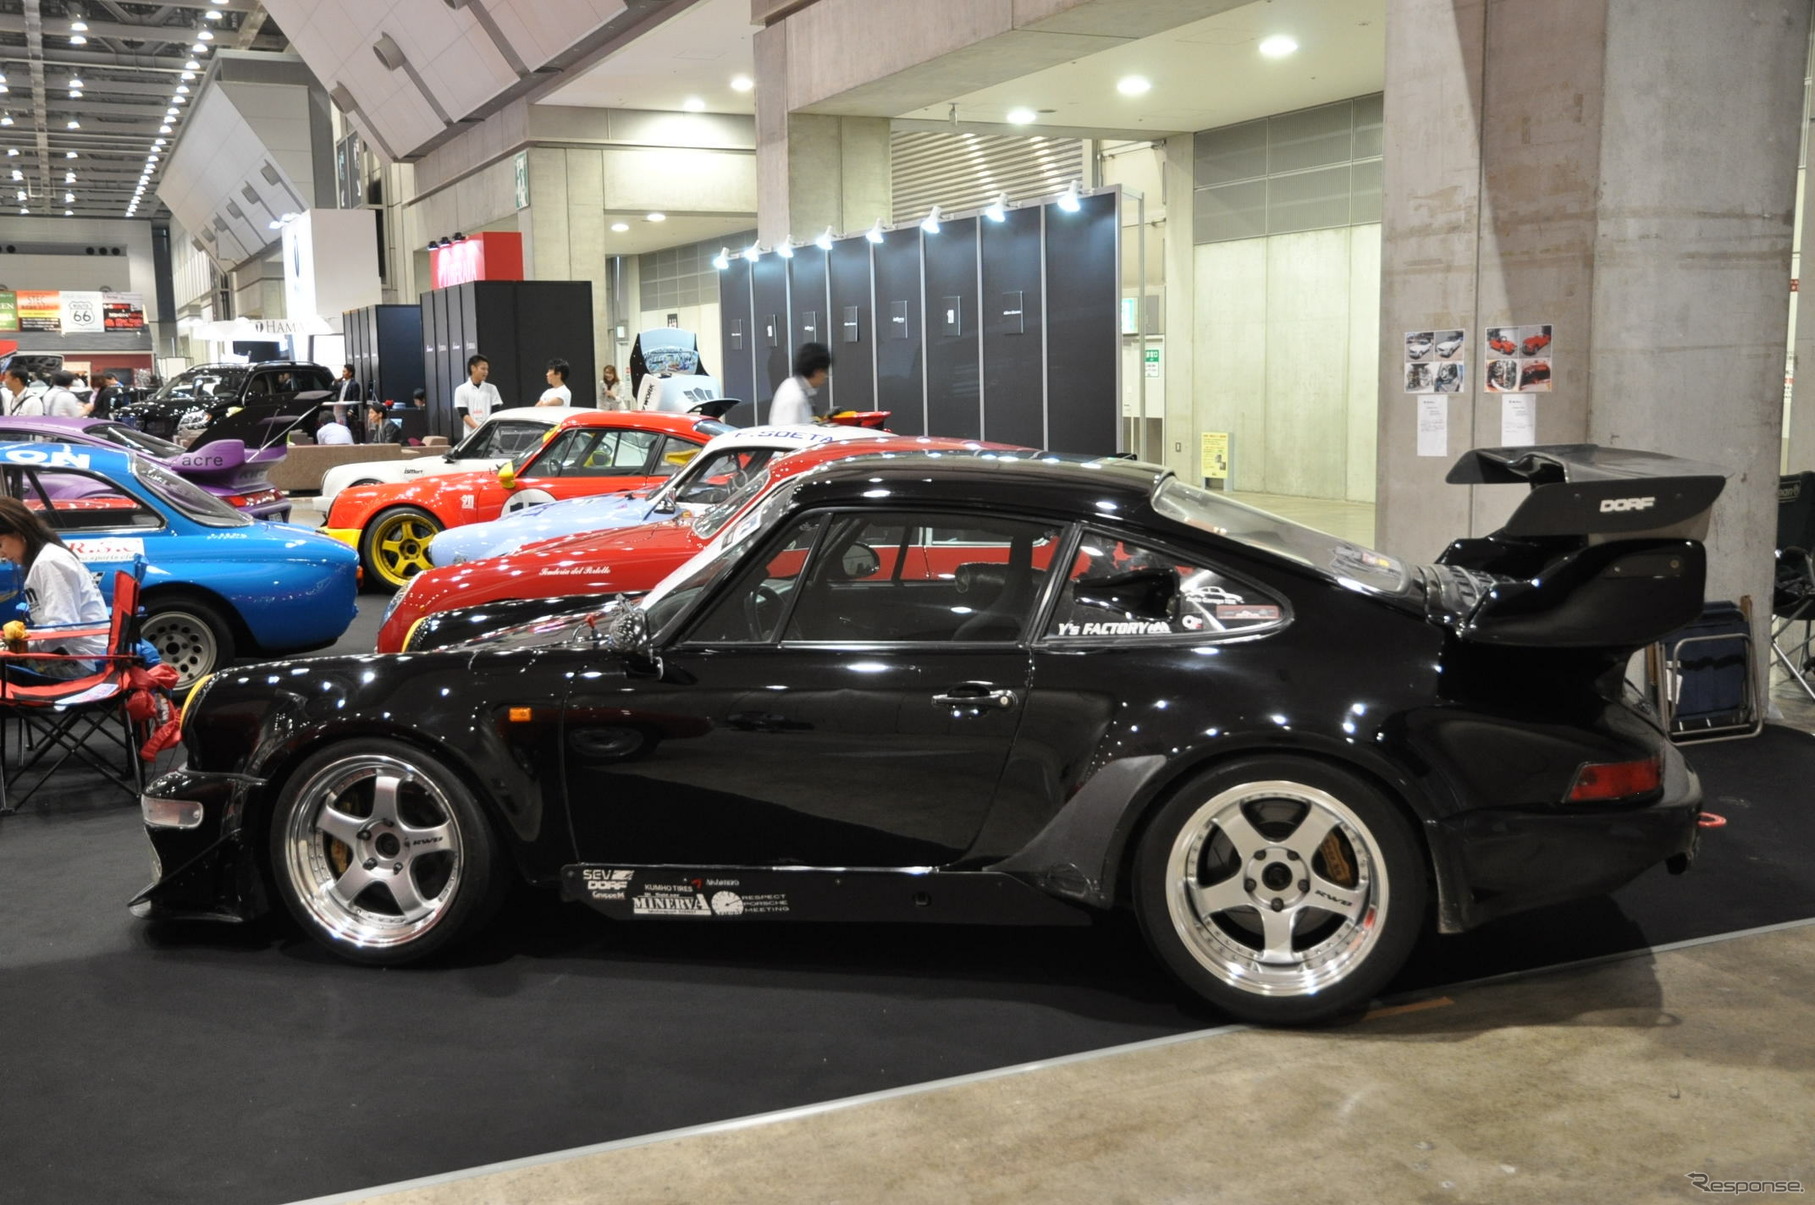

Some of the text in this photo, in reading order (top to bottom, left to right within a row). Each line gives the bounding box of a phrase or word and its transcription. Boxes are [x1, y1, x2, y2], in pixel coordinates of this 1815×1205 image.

[73, 310, 92, 322] 66
[182, 455, 224, 467] acre
[1599, 497, 1656, 513] DORF
[571, 566, 585, 580] del
[1058, 621, 1149, 636] Y's FACTORY
[583, 869, 611, 881] SEV
[588, 881, 628, 890] DORF
[672, 885, 694, 893] TIRES
[632, 893, 711, 911] MINERVA
[1314, 889, 1353, 907] RWB
